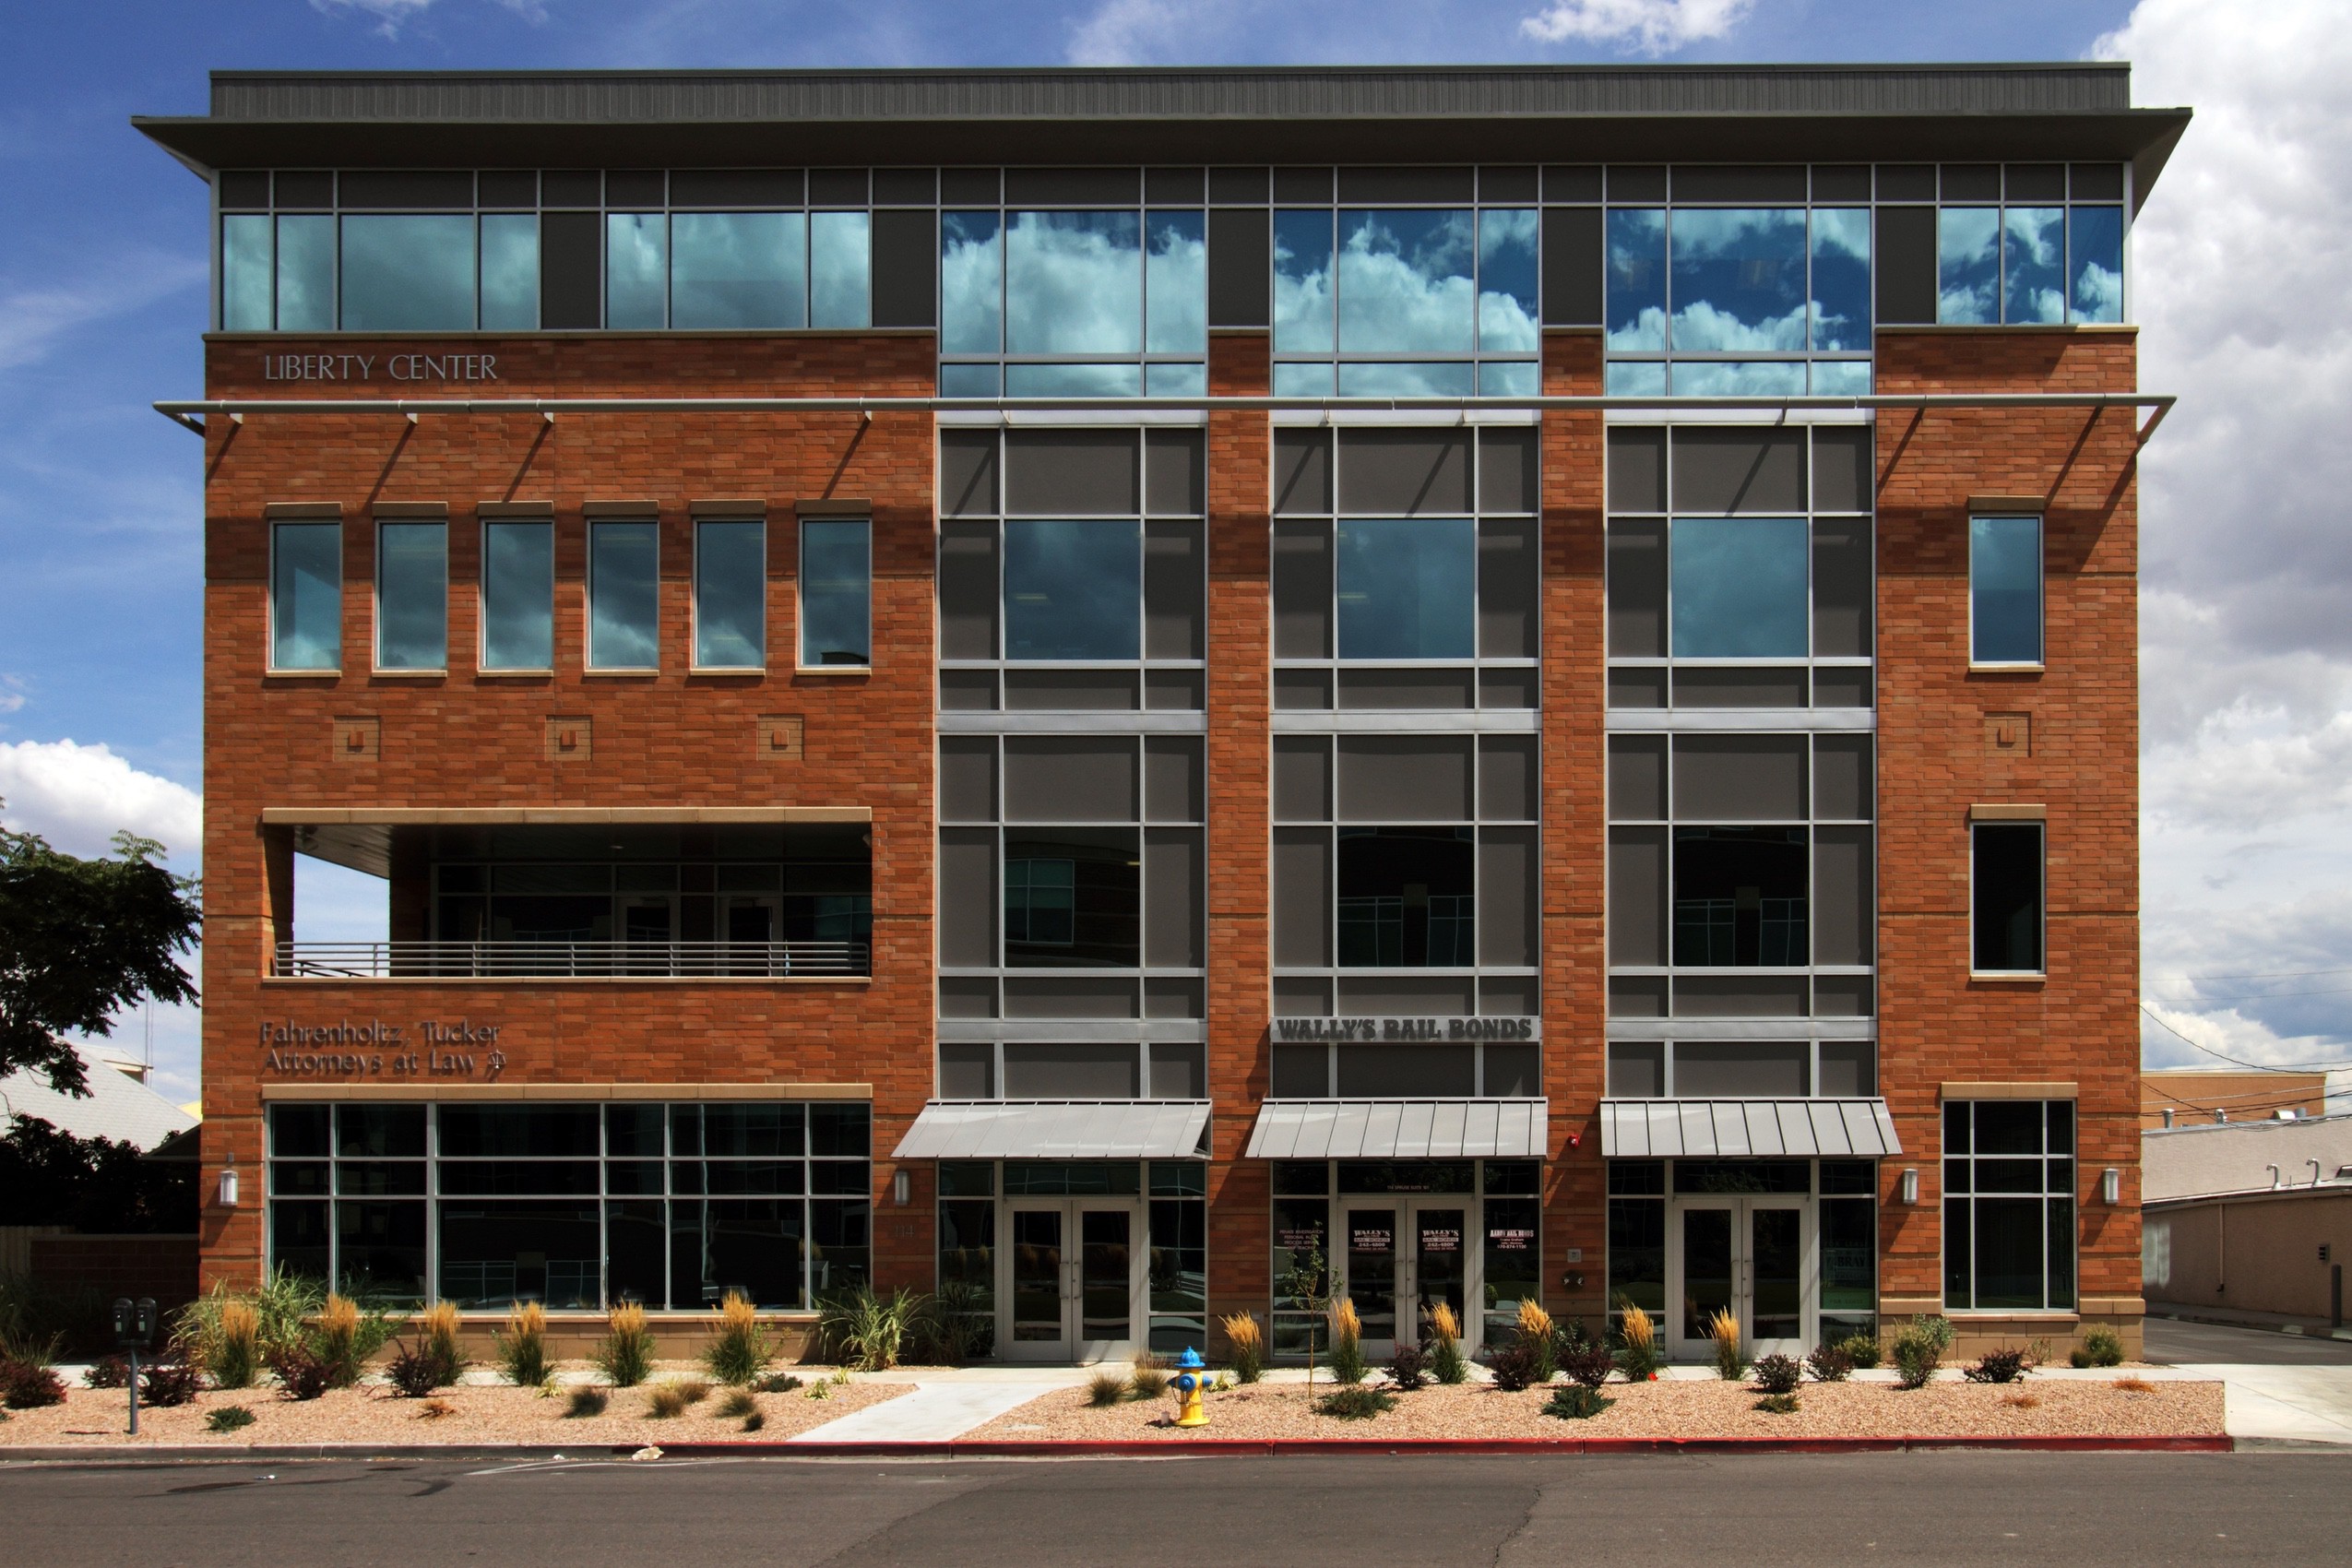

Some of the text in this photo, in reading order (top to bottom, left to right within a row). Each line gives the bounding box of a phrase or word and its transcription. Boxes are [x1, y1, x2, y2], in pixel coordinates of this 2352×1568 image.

[265, 354, 498, 380] LIBERTY CENTER
[260, 1018, 501, 1046] Fahrenholtz, Tucker
[1277, 1018, 1533, 1040] WALLY'S BAIL BONDS
[264, 1049, 475, 1074] Attorneys at Law
[894, 1224, 915, 1238] 114
[1836, 1256, 1866, 1267] BRAY
